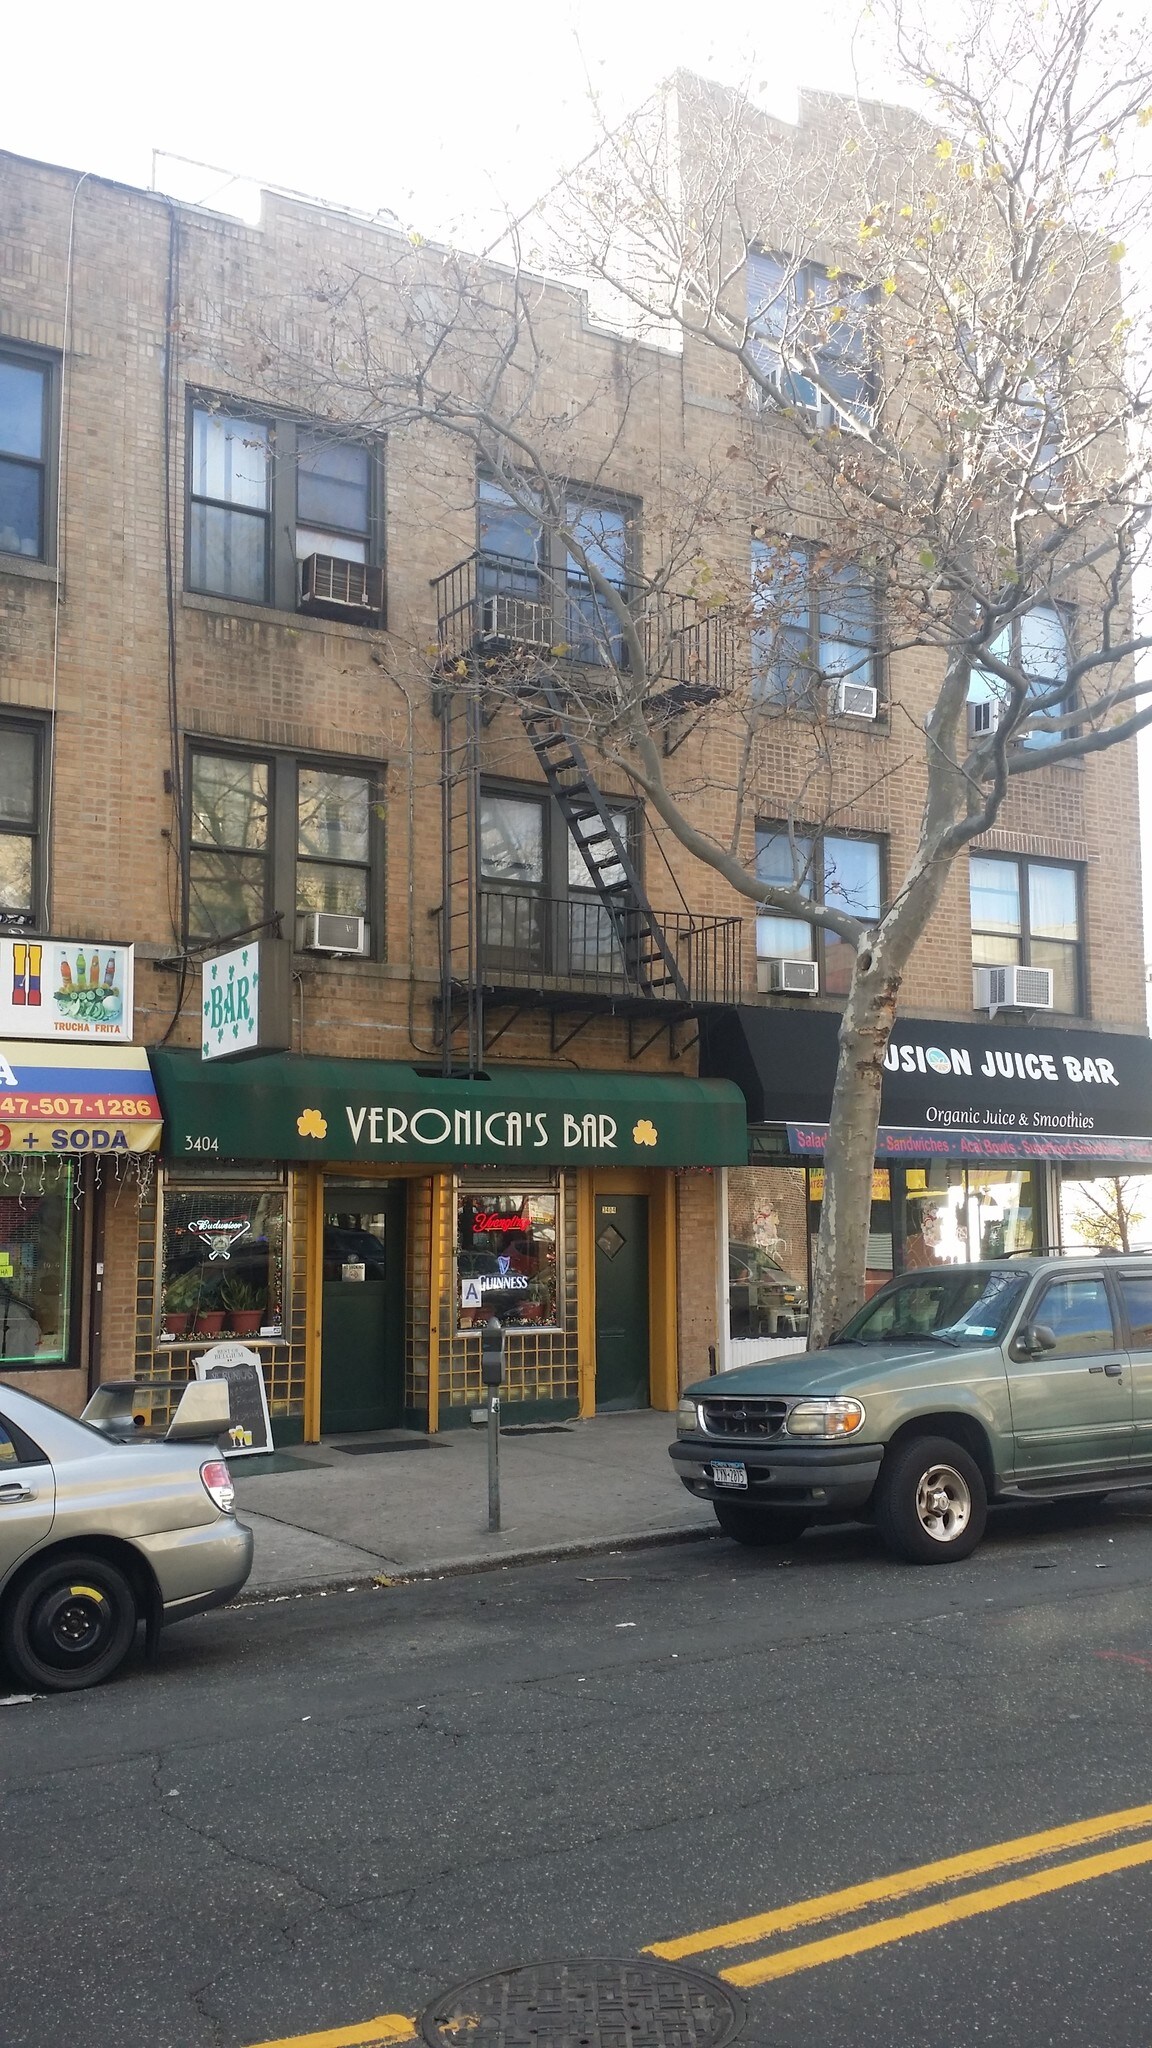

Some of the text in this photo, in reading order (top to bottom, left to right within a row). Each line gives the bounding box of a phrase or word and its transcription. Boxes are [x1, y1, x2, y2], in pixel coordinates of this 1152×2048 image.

[210, 975, 250, 1029] BAR
[54, 1021, 121, 1034] TRUCHA FRITA
[883, 1044, 1120, 1086] USION JUICE BAR
[0, 1097, 151, 1116] 47-507-1286
[345, 1106, 618, 1148] VERONICA'S BAR
[926, 1106, 1094, 1129] Organic Juice & Smoothies
[52, 1129, 129, 1149] SODA
[184, 1136, 219, 1151] 3404
[886, 1136, 949, 1152] Sandwiches
[984, 1138, 1015, 1154] Bowls
[465, 1283, 478, 1300] A
[478, 1275, 528, 1291] GUINNESS
